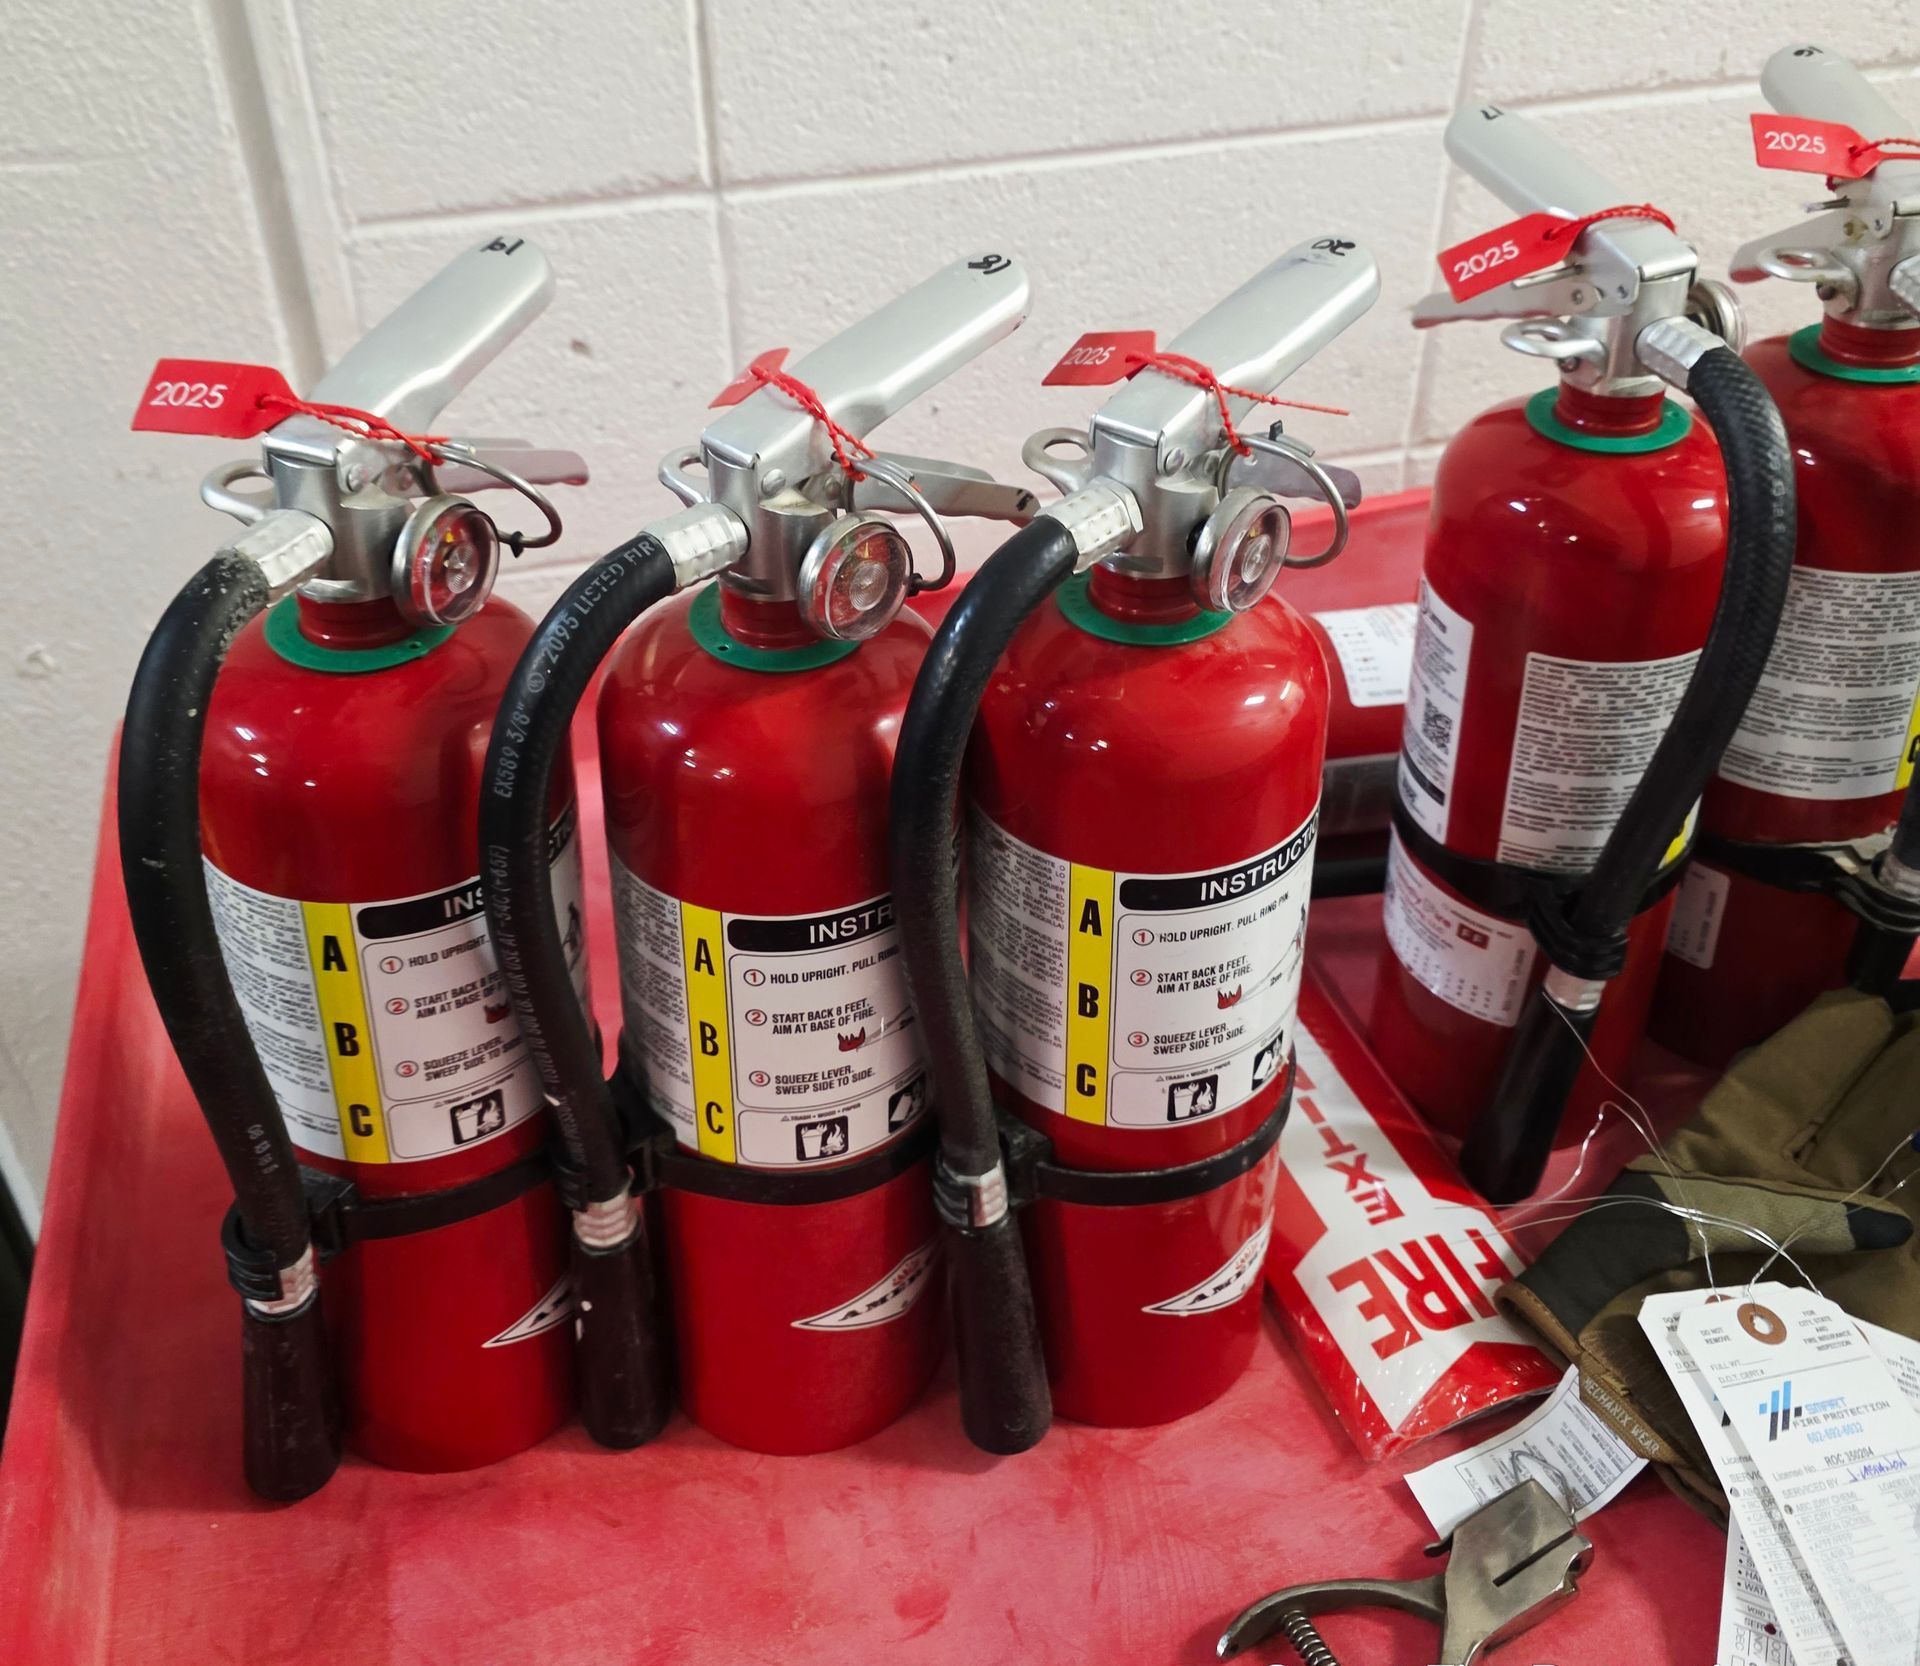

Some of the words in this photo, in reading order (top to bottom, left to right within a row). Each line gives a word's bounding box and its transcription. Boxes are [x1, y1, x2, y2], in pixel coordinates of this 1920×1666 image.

[1763, 130, 1827, 155] 2025
[1453, 240, 1520, 283] 2025
[1062, 345, 1117, 366] 2025
[150, 381, 228, 408] 2025
[545, 616, 579, 666] 2095
[572, 562, 626, 615] LISTED
[624, 539, 656, 565] FIR
[1079, 899, 1102, 937] A
[1159, 930, 1187, 943] HOLD
[1190, 923, 1235, 941] UPRIGHT.
[1237, 913, 1257, 928] PULL
[1260, 900, 1277, 918] RING
[322, 935, 348, 973] A
[408, 952, 438, 967] HOLD
[694, 938, 715, 976] A
[771, 973, 798, 984] HOLD
[802, 965, 850, 982] UPRIGHT.
[853, 955, 876, 972] PULL
[1156, 982, 1176, 994] AIM
[1178, 979, 1192, 992] AT
[1193, 974, 1217, 990] BASE
[1218, 970, 1230, 985] OF
[1232, 964, 1253, 982] FIRE.
[1157, 971, 1189, 984] START
[1191, 966, 1217, 981] BACK
[1218, 963, 1225, 974] 8
[1226, 955, 1248, 972] FEET.
[415, 991, 448, 1008] START
[451, 982, 478, 998] BACK
[416, 1006, 437, 1019] AIM
[440, 1001, 452, 1014] AT
[455, 991, 480, 1009] BASE
[1078, 983, 1099, 1019] B
[772, 1012, 805, 1024] START
[807, 1008, 834, 1022] BACK
[836, 1006, 842, 1017] 8
[844, 998, 870, 1015] FEET.
[773, 1023, 792, 1034] AIM
[794, 1022, 808, 1033] AT
[810, 1019, 837, 1032] BASE
[838, 1015, 850, 1027] OF
[852, 1005, 877, 1022] FIRE.
[334, 1022, 360, 1057] B
[700, 1021, 719, 1057] B
[1153, 1042, 1187, 1055] SWEEP
[1188, 1038, 1209, 1052] SIDE
[1212, 1035, 1224, 1047] TO
[1226, 1025, 1247, 1044] SIDE.
[1154, 1031, 1196, 1045] SQUEEZE
[1199, 1023, 1229, 1039] LEVER.
[423, 1049, 470, 1070] SQUEEZE
[425, 1064, 460, 1081] SWEEP
[463, 1055, 487, 1070] SIDE
[775, 1072, 818, 1084] SQUEEZE
[821, 1065, 855, 1080] LEVER.
[775, 1084, 810, 1095] SWEEP
[812, 1080, 835, 1092] SIDE
[838, 1077, 850, 1089] TO
[851, 1068, 876, 1085] SIDE.
[1076, 1064, 1097, 1097] C
[350, 1104, 374, 1137] C
[705, 1101, 725, 1135] C
[1792, 1414, 1822, 1429] FIRE
[1823, 1400, 1891, 1421] PROTECTION
[1631, 1422, 1660, 1457] WEAR
